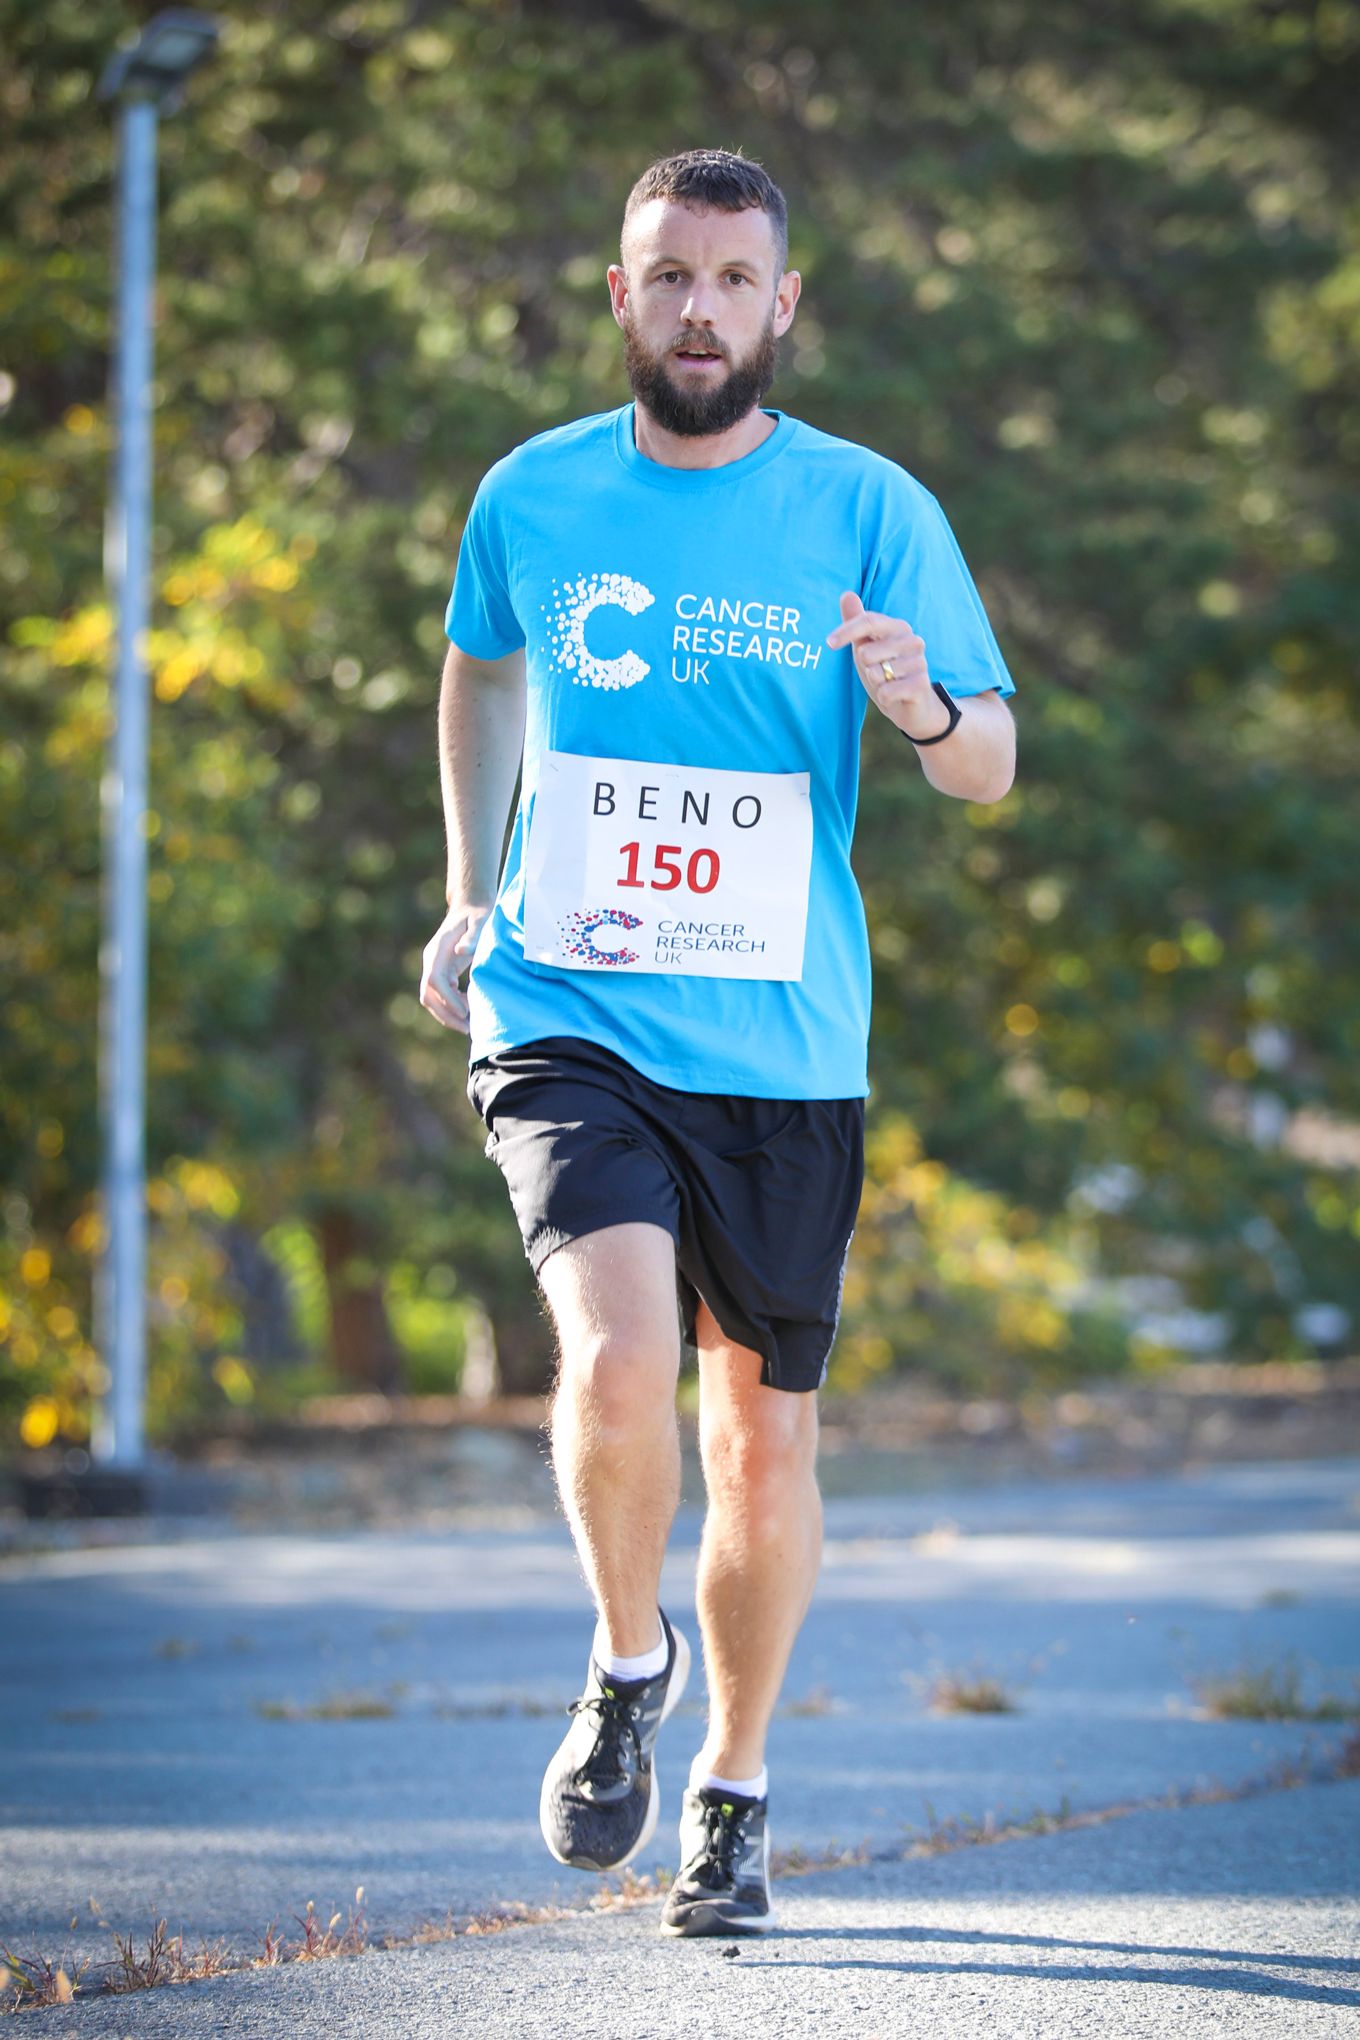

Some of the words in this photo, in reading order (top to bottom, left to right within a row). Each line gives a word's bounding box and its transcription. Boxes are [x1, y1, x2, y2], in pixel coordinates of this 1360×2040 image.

[675, 594, 800, 634] CANCER
[673, 625, 822, 670] RESEARCH
[671, 656, 710, 685] UK
[593, 782, 762, 829] BENO
[617, 841, 720, 894] 150
[656, 936, 766, 953] RESEARCH
[657, 920, 745, 937] CANCER
[654, 952, 682, 964] UK
